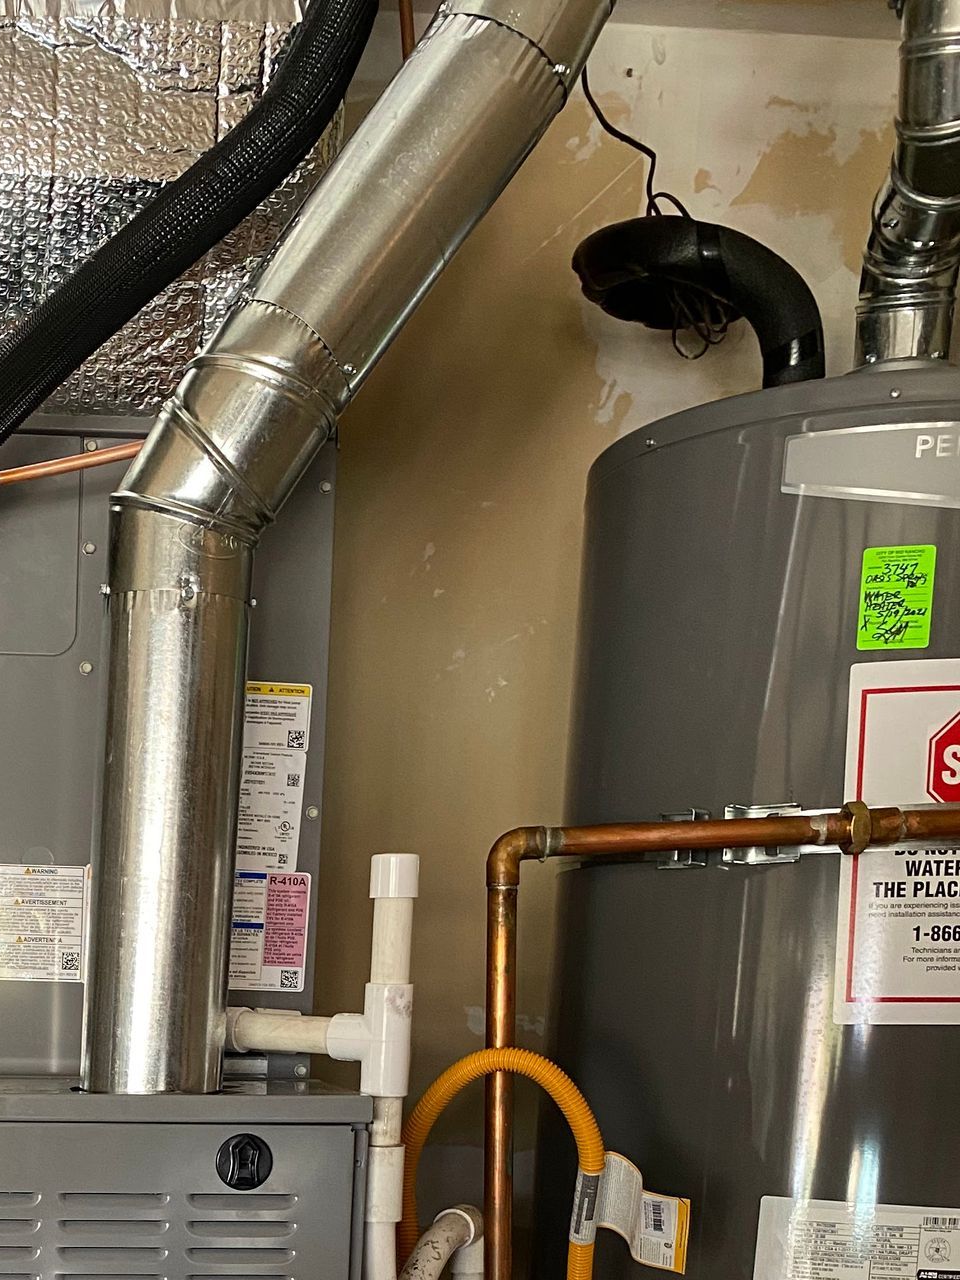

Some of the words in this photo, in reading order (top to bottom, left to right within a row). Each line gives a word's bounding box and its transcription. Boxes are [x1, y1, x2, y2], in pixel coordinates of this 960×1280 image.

[915, 435, 960, 458] PE
[882, 563, 918, 575] 3747
[270, 876, 306, 887] R-410A
[873, 882, 906, 898] THE
[913, 881, 960, 898] PLAC
